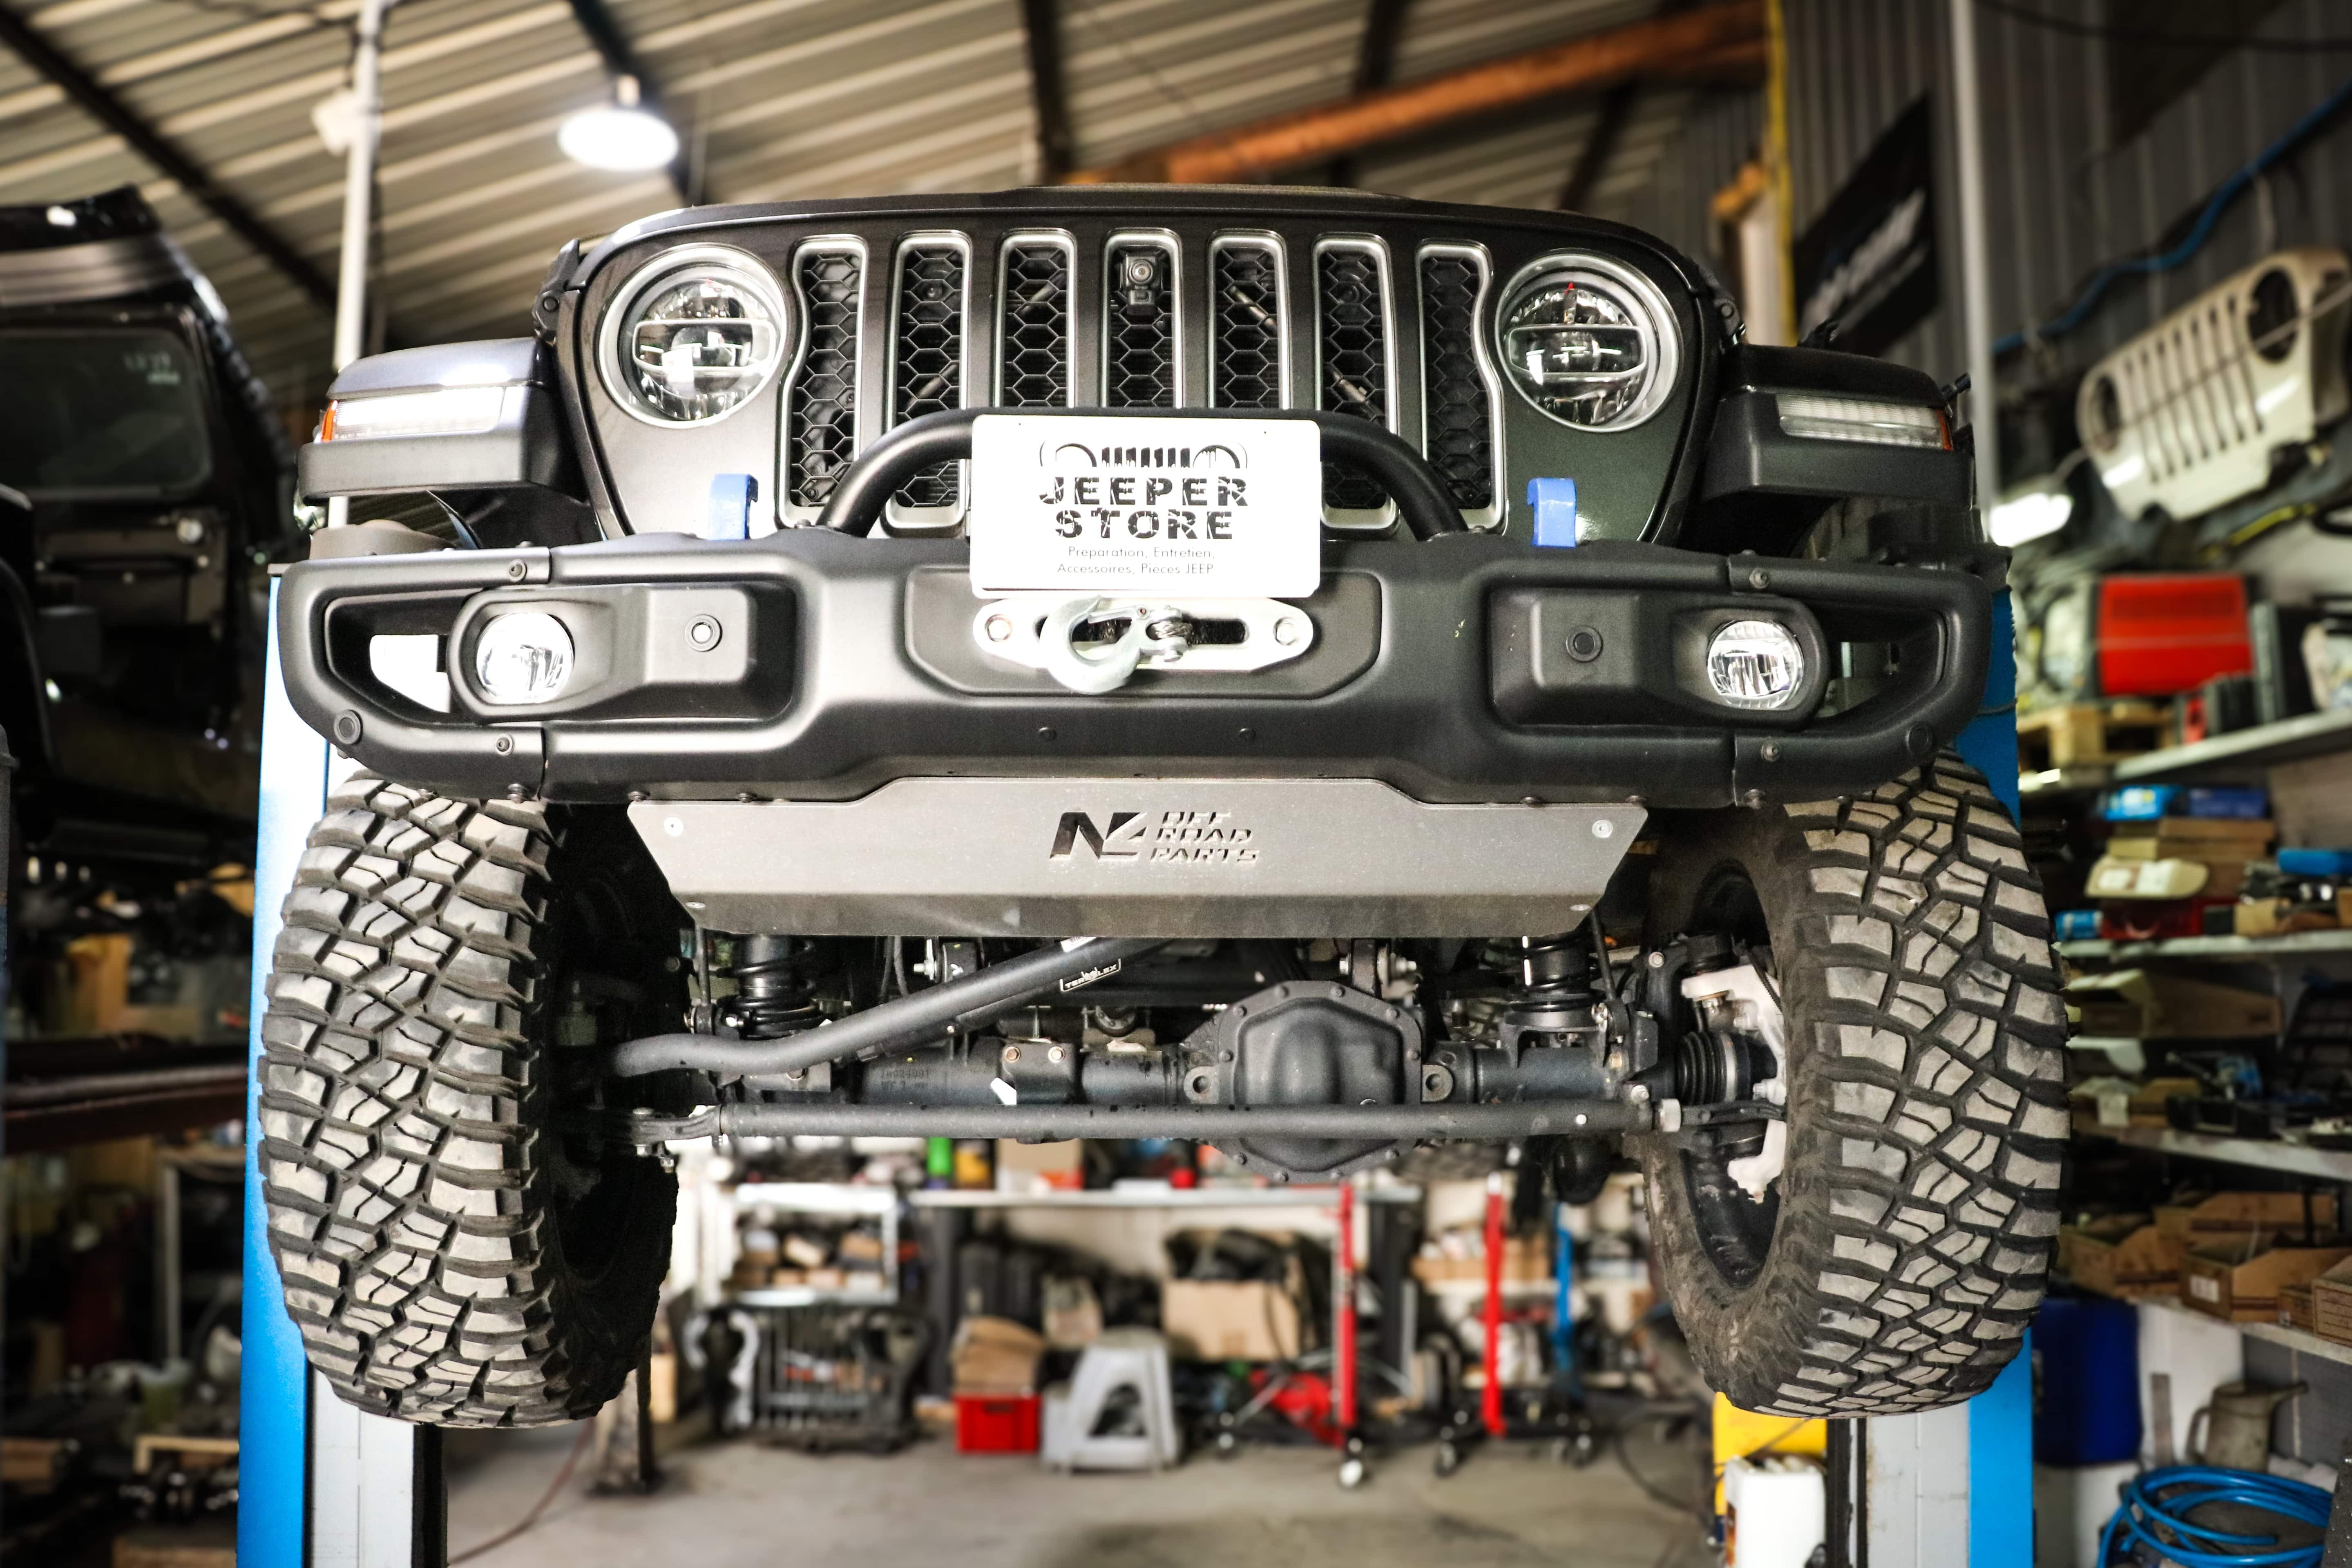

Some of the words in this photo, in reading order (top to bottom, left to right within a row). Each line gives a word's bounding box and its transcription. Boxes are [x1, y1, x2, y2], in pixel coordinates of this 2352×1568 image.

[1039, 476, 1248, 506] JEEPER
[1055, 507, 1233, 540] STORE
[1068, 546, 1148, 559] Preparation,
[1154, 547, 1215, 559] Entretien,
[1057, 563, 1135, 575] Accessoires,
[1185, 563, 1214, 574] JEEP
[1161, 811, 1231, 826] OFF
[1156, 828, 1252, 843] ROAD
[1149, 848, 1260, 863] PARTS
